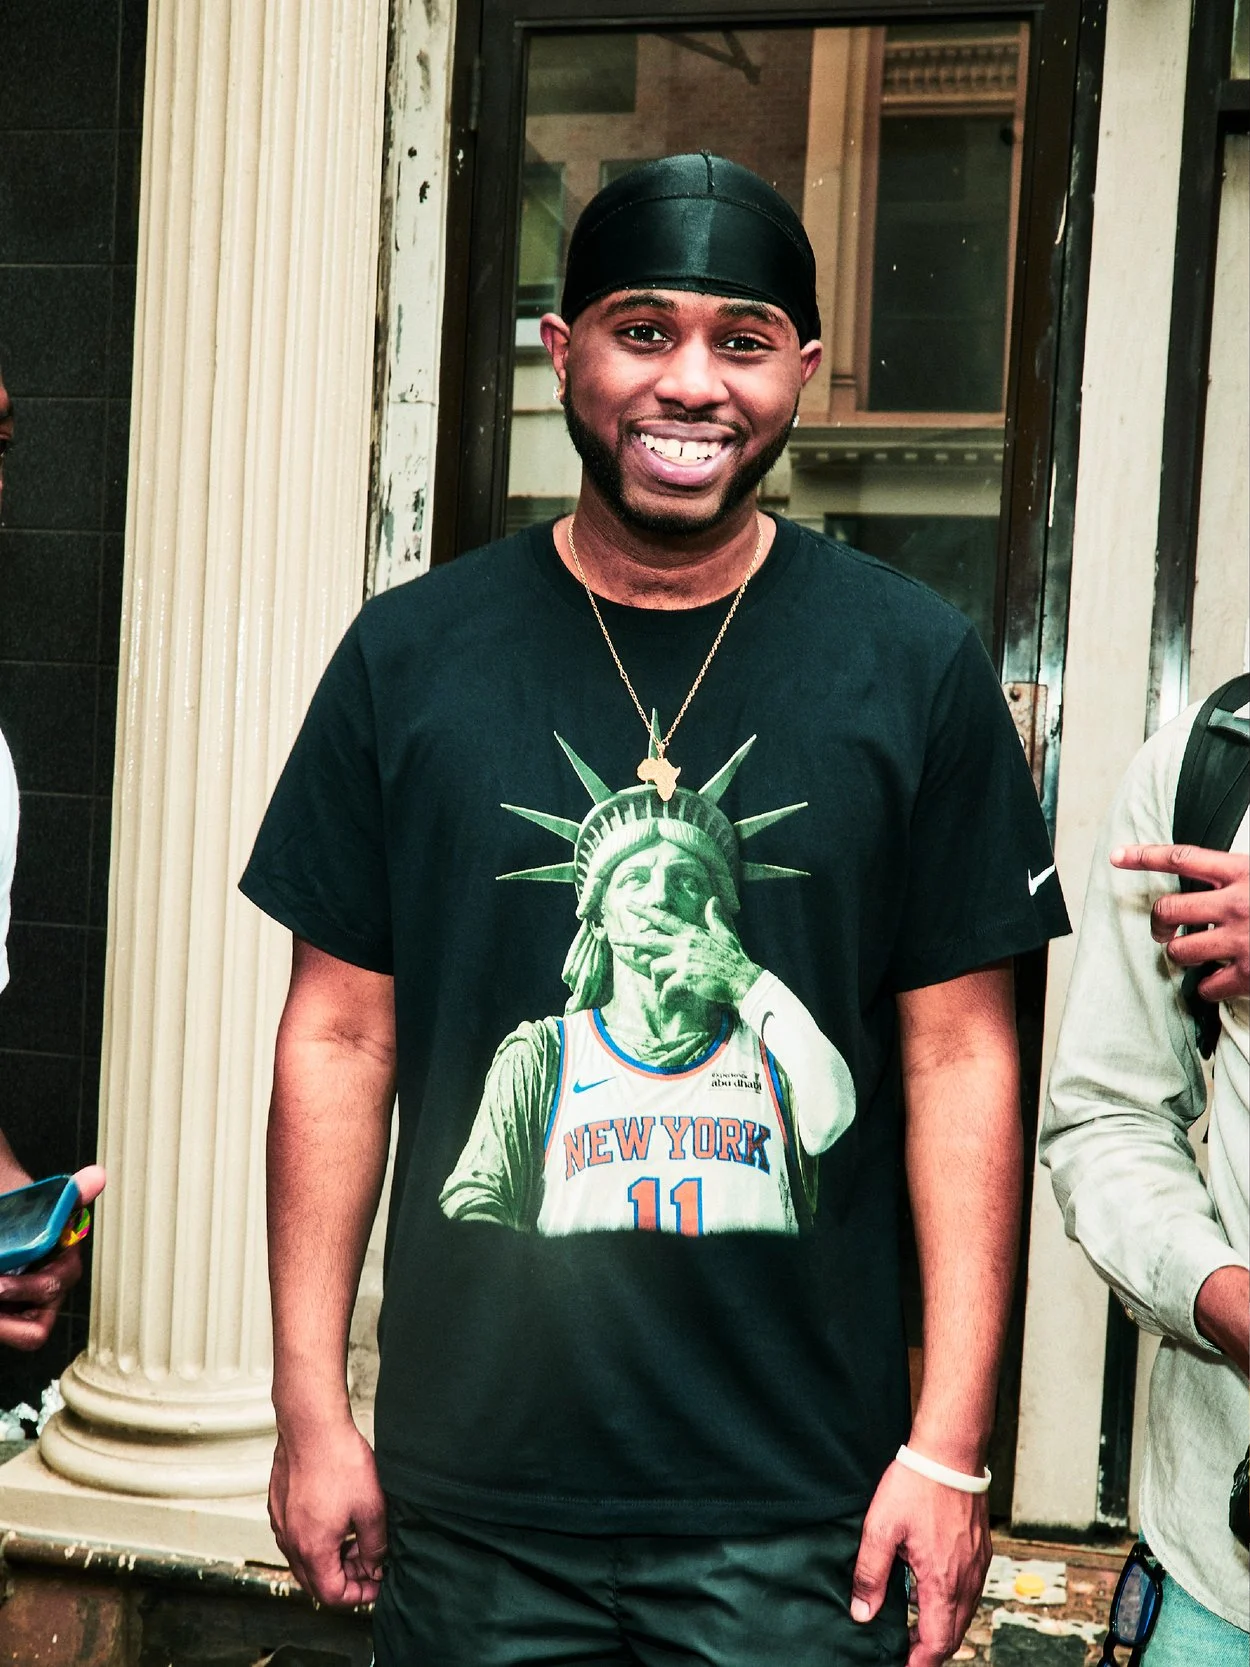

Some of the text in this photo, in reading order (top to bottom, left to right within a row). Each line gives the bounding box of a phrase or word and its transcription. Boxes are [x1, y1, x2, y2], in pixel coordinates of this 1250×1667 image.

[711, 1079, 731, 1088] abu
[563, 1115, 772, 1181] NEW YORK
[627, 1176, 704, 1238] 11
